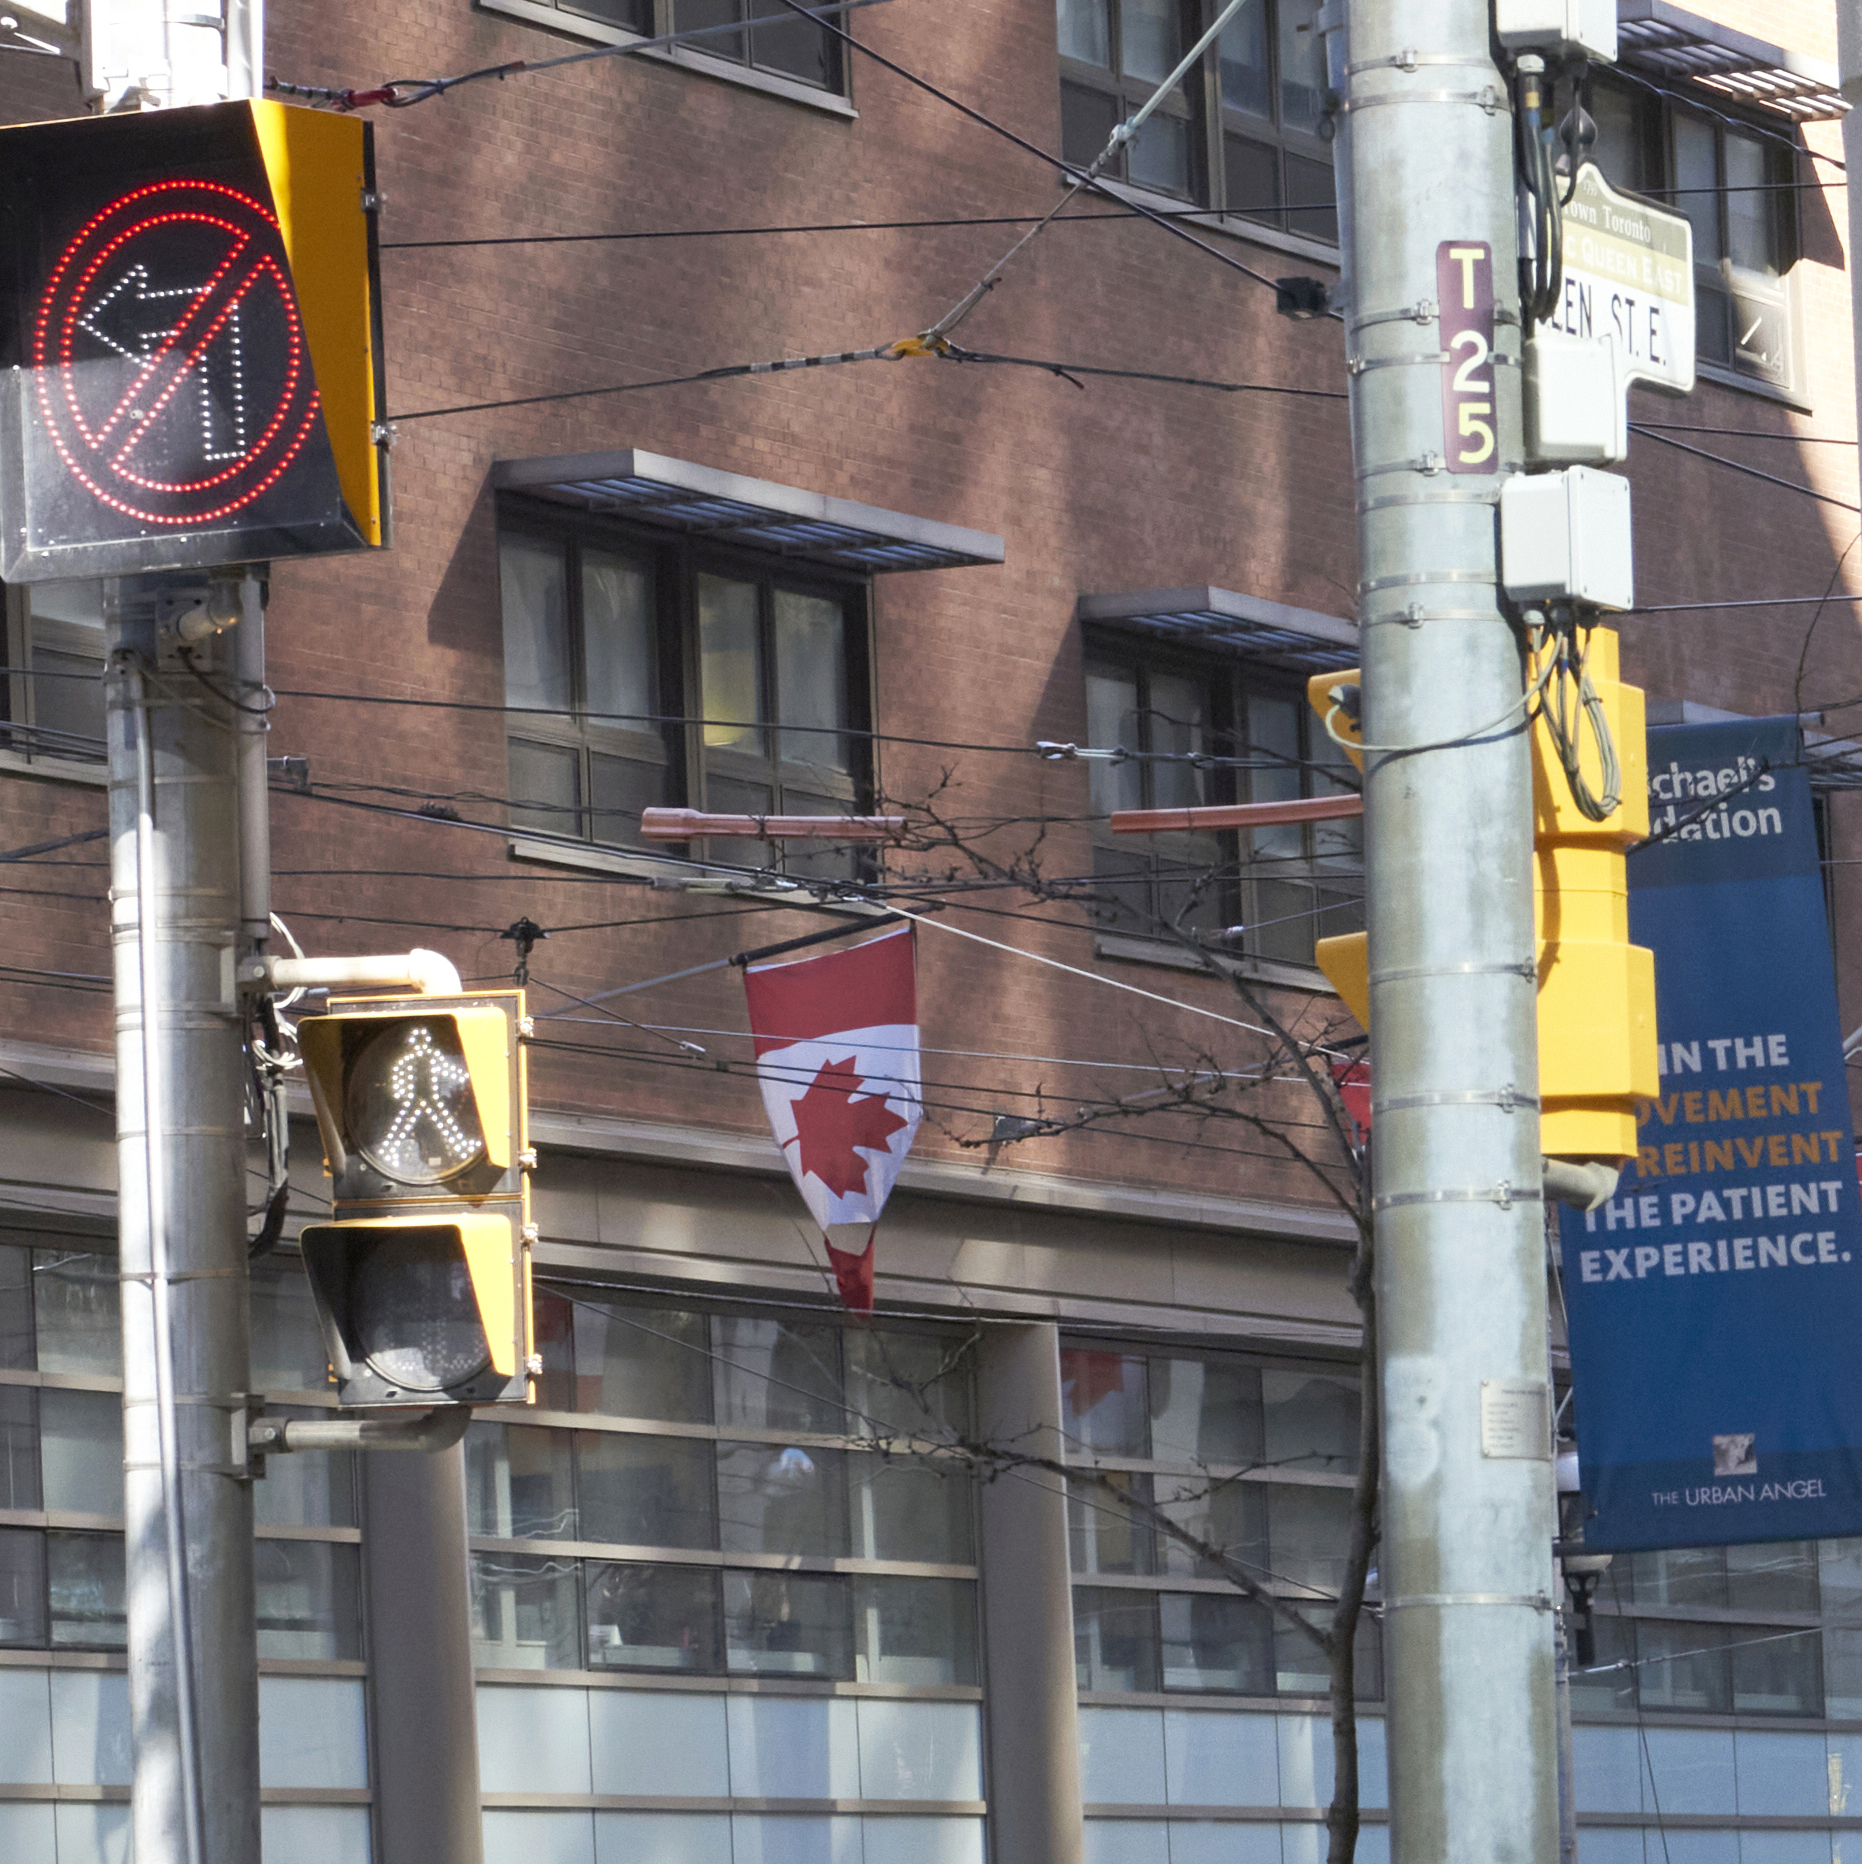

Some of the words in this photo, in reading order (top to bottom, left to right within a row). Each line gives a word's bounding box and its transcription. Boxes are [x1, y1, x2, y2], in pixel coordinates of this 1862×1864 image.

[1603, 205, 1650, 243] Toronto
[1650, 306, 1667, 366] E.
[1707, 1034, 1789, 1071] THE
[1635, 1131, 1843, 1178] REINVENT
[1670, 1181, 1843, 1225] PATIENT
[1580, 1231, 1851, 1283] EXPERIENCE.
[1652, 1491, 1679, 1505] THE
[1685, 1484, 1754, 1506] URBAN
[1759, 1479, 1827, 1501] ANGEL
